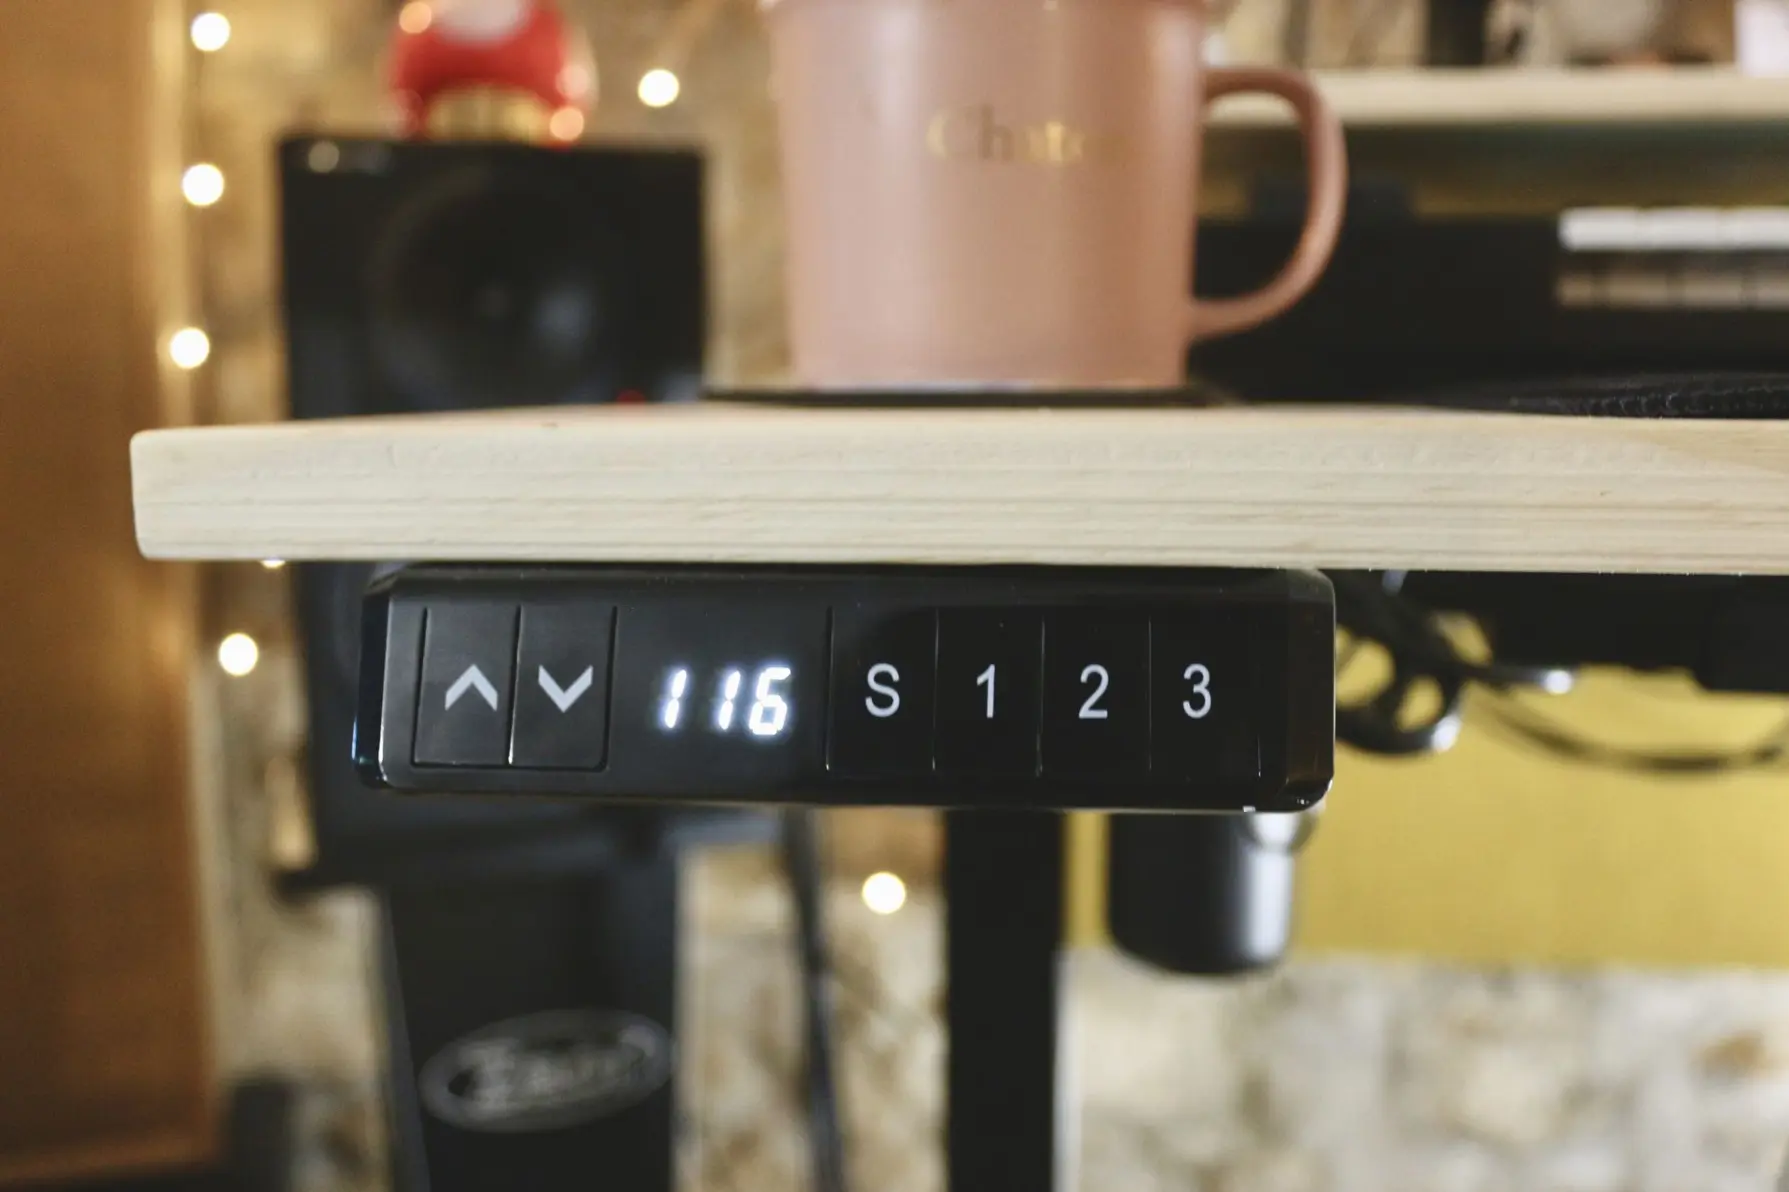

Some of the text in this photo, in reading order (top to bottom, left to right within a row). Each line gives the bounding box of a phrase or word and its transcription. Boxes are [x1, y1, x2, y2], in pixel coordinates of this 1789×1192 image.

[664, 666, 791, 735] 116
[865, 662, 1212, 719] S 1 2 3
